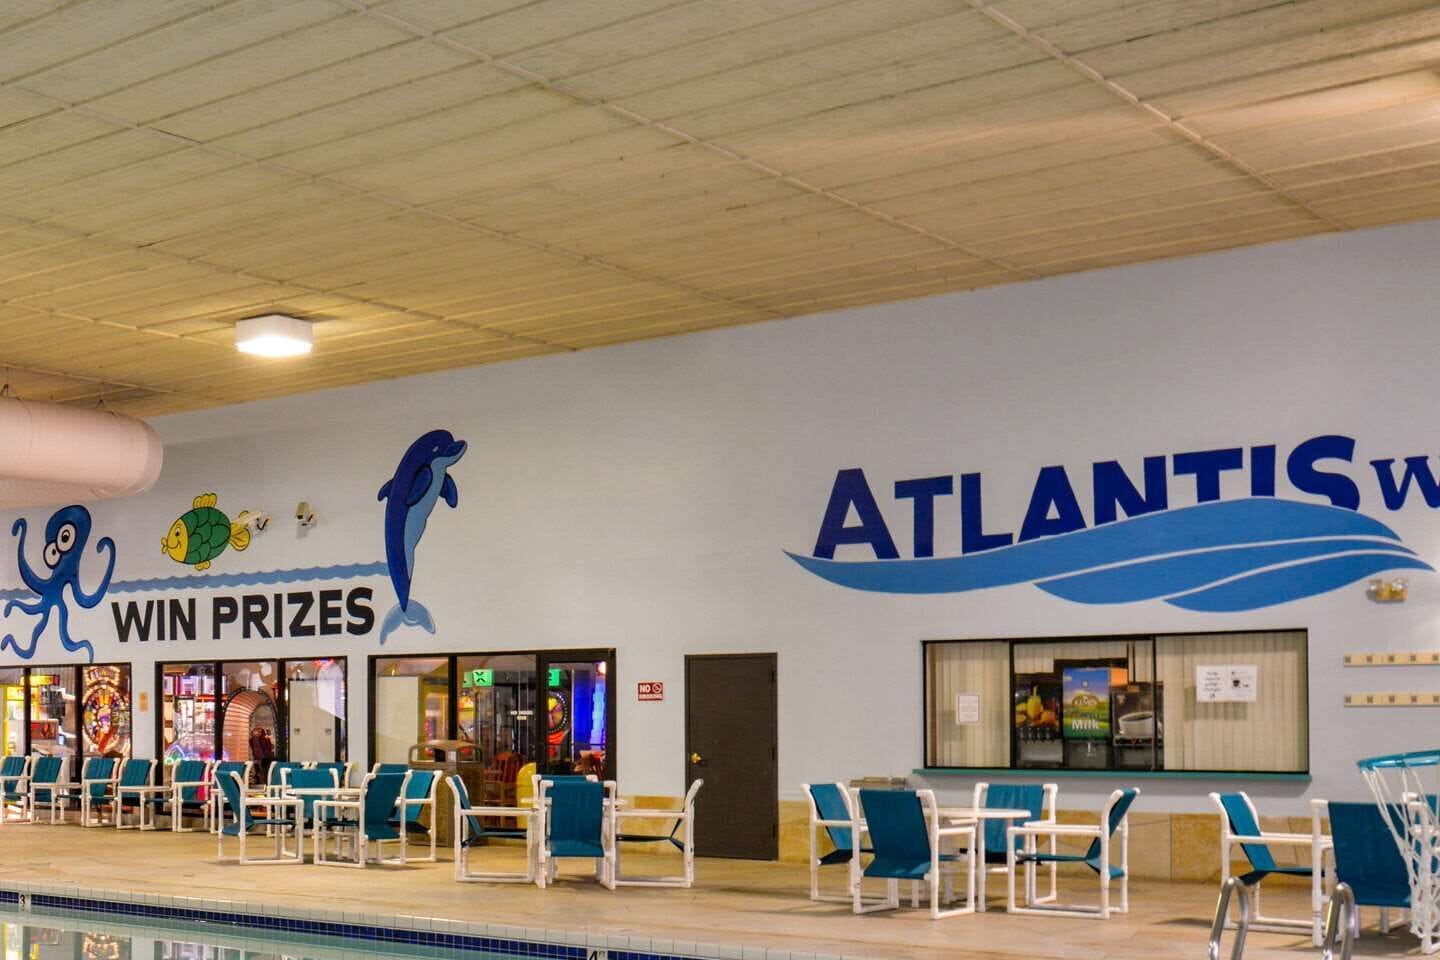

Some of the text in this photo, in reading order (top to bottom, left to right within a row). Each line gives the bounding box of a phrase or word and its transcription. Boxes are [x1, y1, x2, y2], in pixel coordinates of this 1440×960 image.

[813, 434, 1360, 560] ATLANTIS
[112, 587, 375, 642] WIN PRIZES
[639, 684, 651, 693] NO
[1072, 719, 1100, 730] Milk
